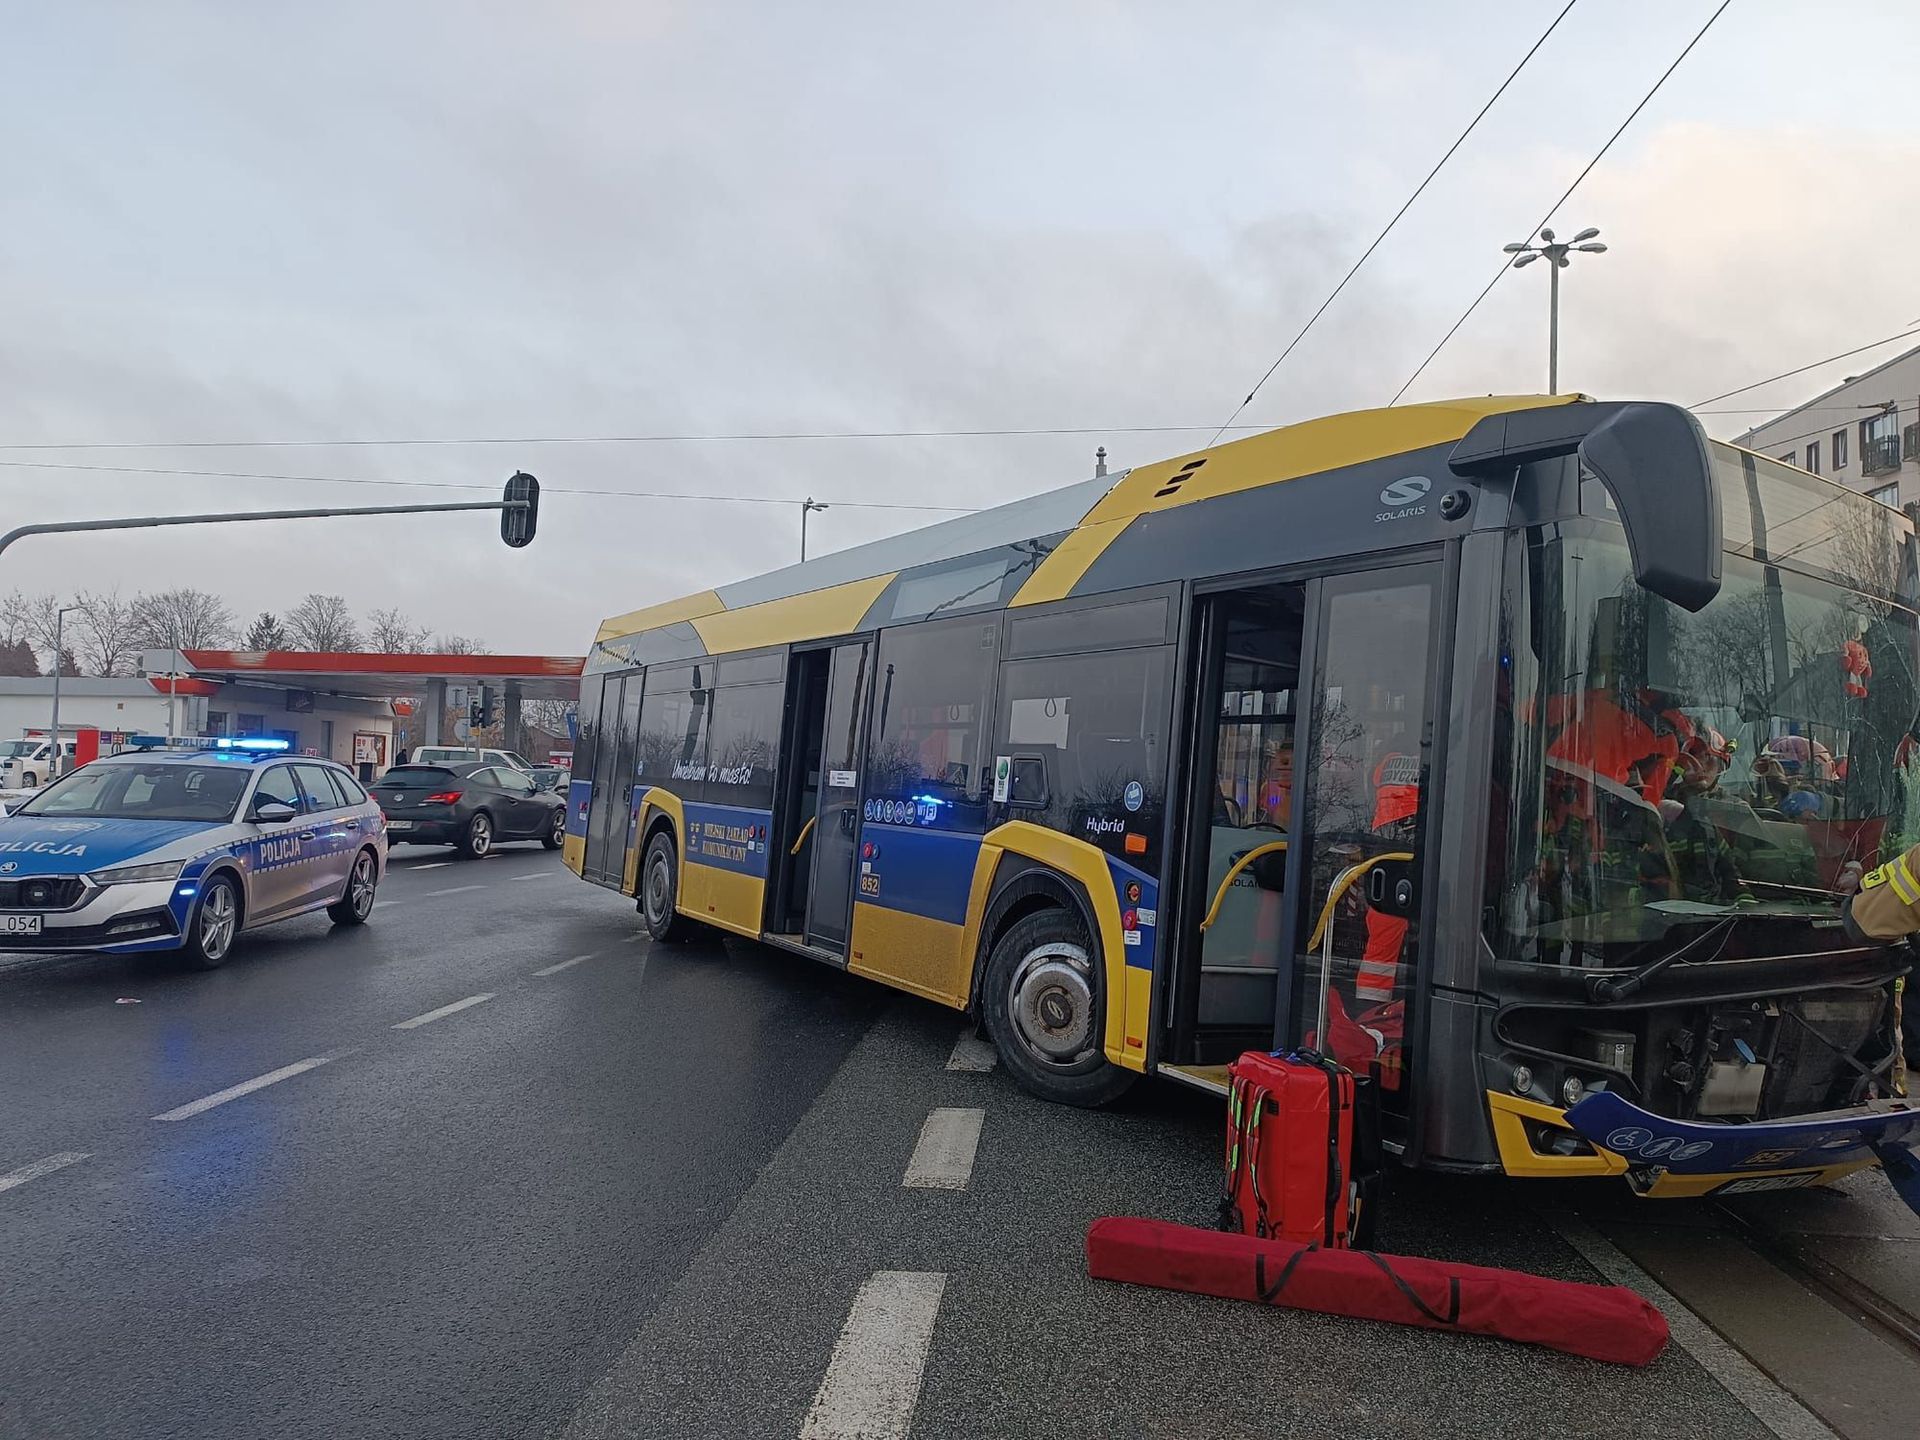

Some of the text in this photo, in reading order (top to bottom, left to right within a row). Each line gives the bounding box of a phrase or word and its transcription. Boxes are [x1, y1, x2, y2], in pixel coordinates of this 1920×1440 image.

[1374, 505, 1426, 523] SOLARIS
[708, 760, 718, 782] to
[719, 762, 754, 785] miasto!
[1086, 816, 1125, 835] Hybrid
[260, 836, 301, 865] POLICJA
[861, 877, 879, 893] 852
[0, 916, 38, 931] 054
